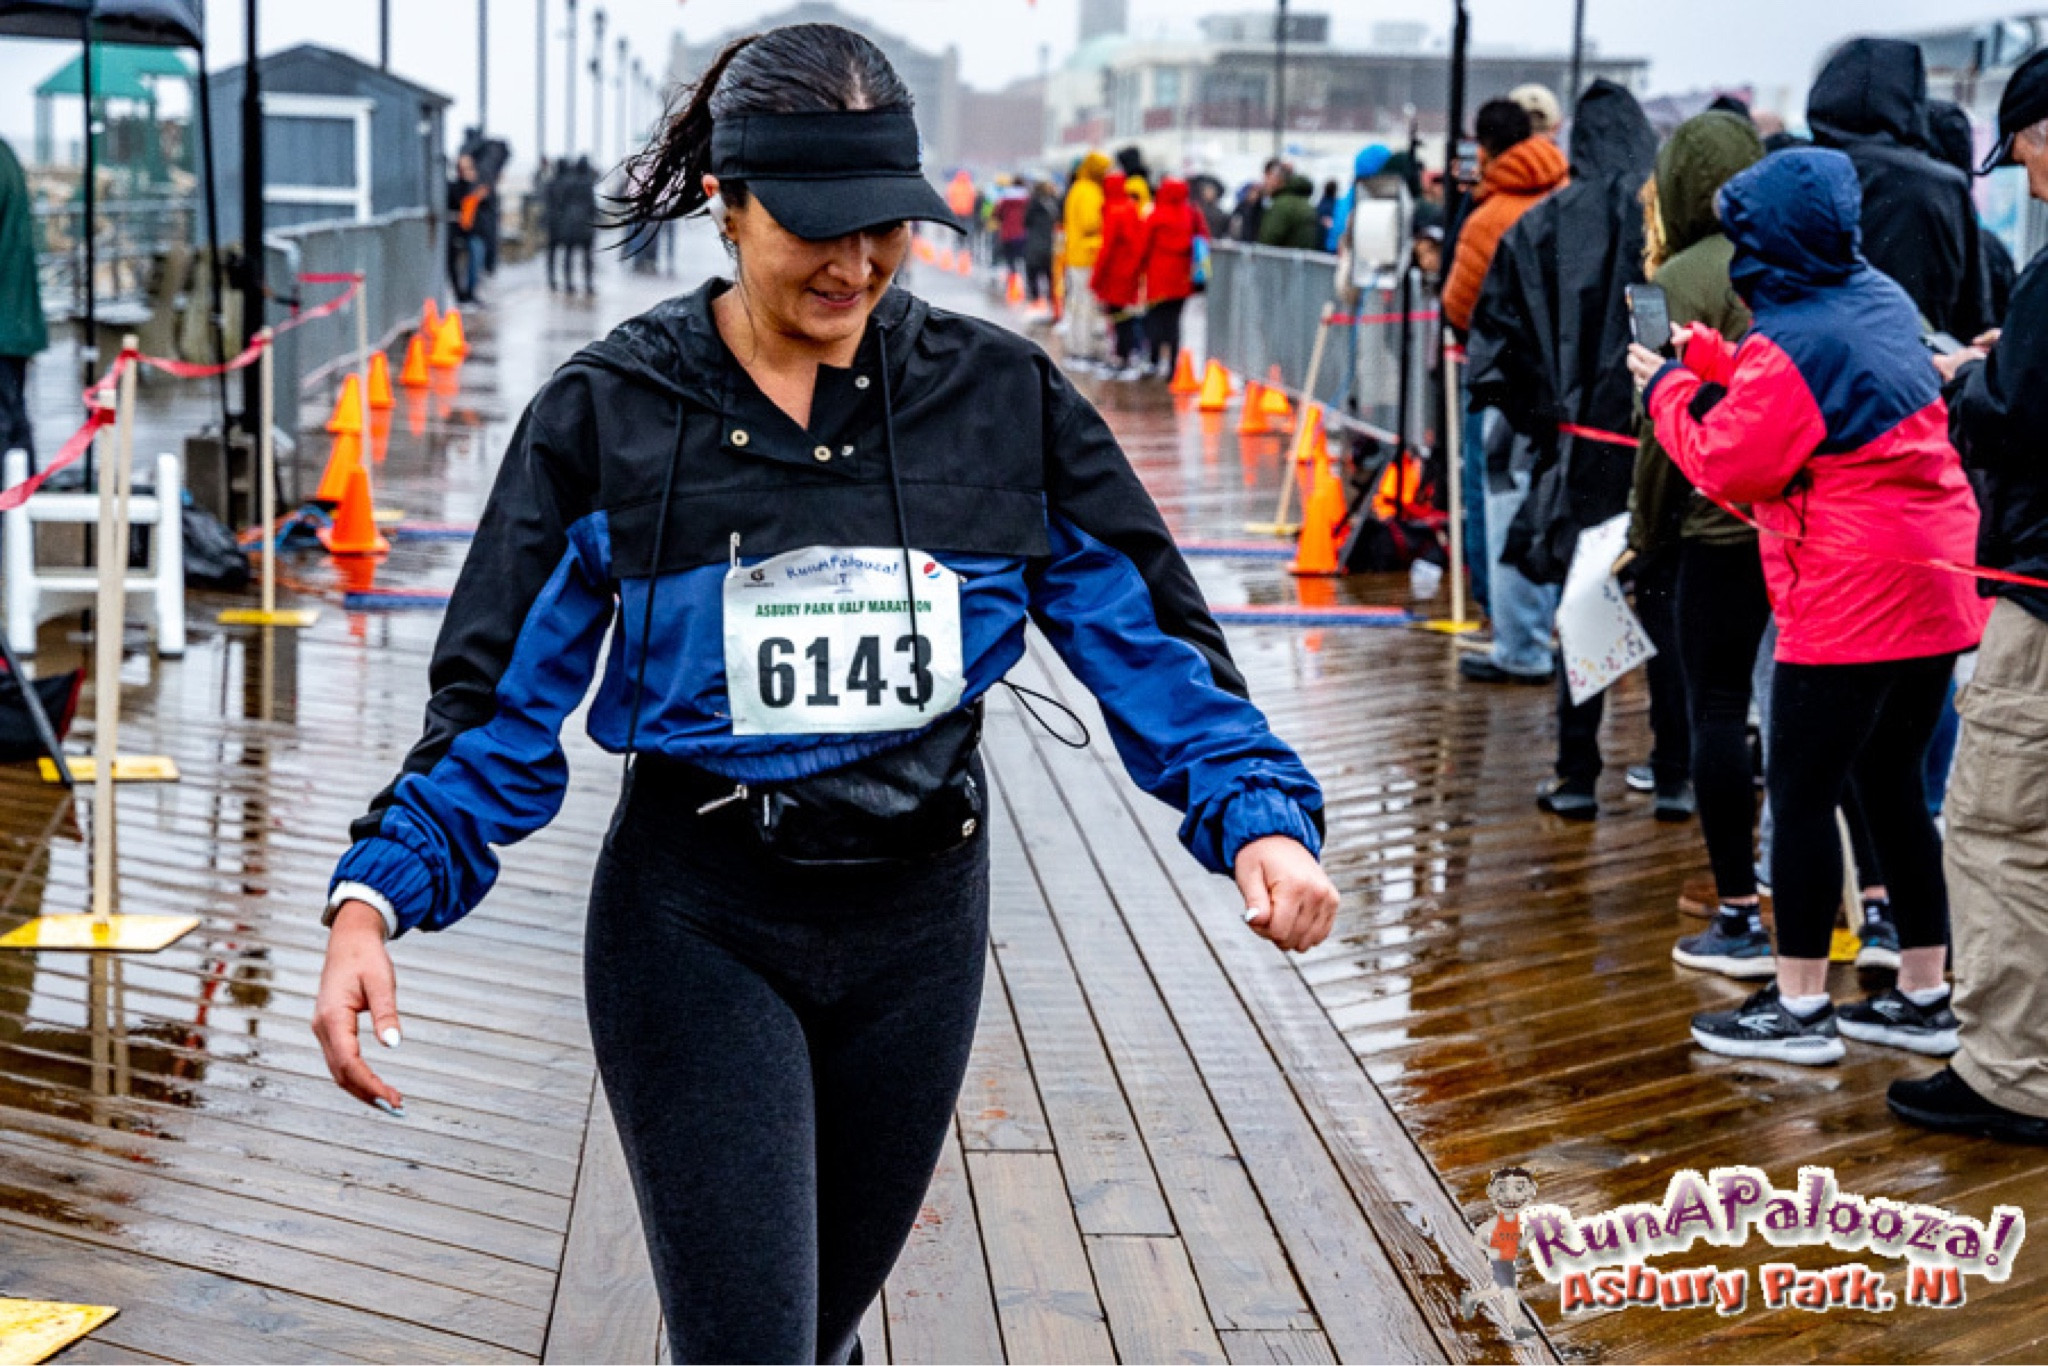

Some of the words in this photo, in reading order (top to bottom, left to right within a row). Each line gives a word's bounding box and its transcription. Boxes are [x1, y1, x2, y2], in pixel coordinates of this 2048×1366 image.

[755, 603, 801, 617] ASBURY
[803, 602, 836, 615] PARK
[837, 601, 866, 615] HALF
[867, 600, 932, 613] MARATON
[757, 634, 934, 709] 6143
